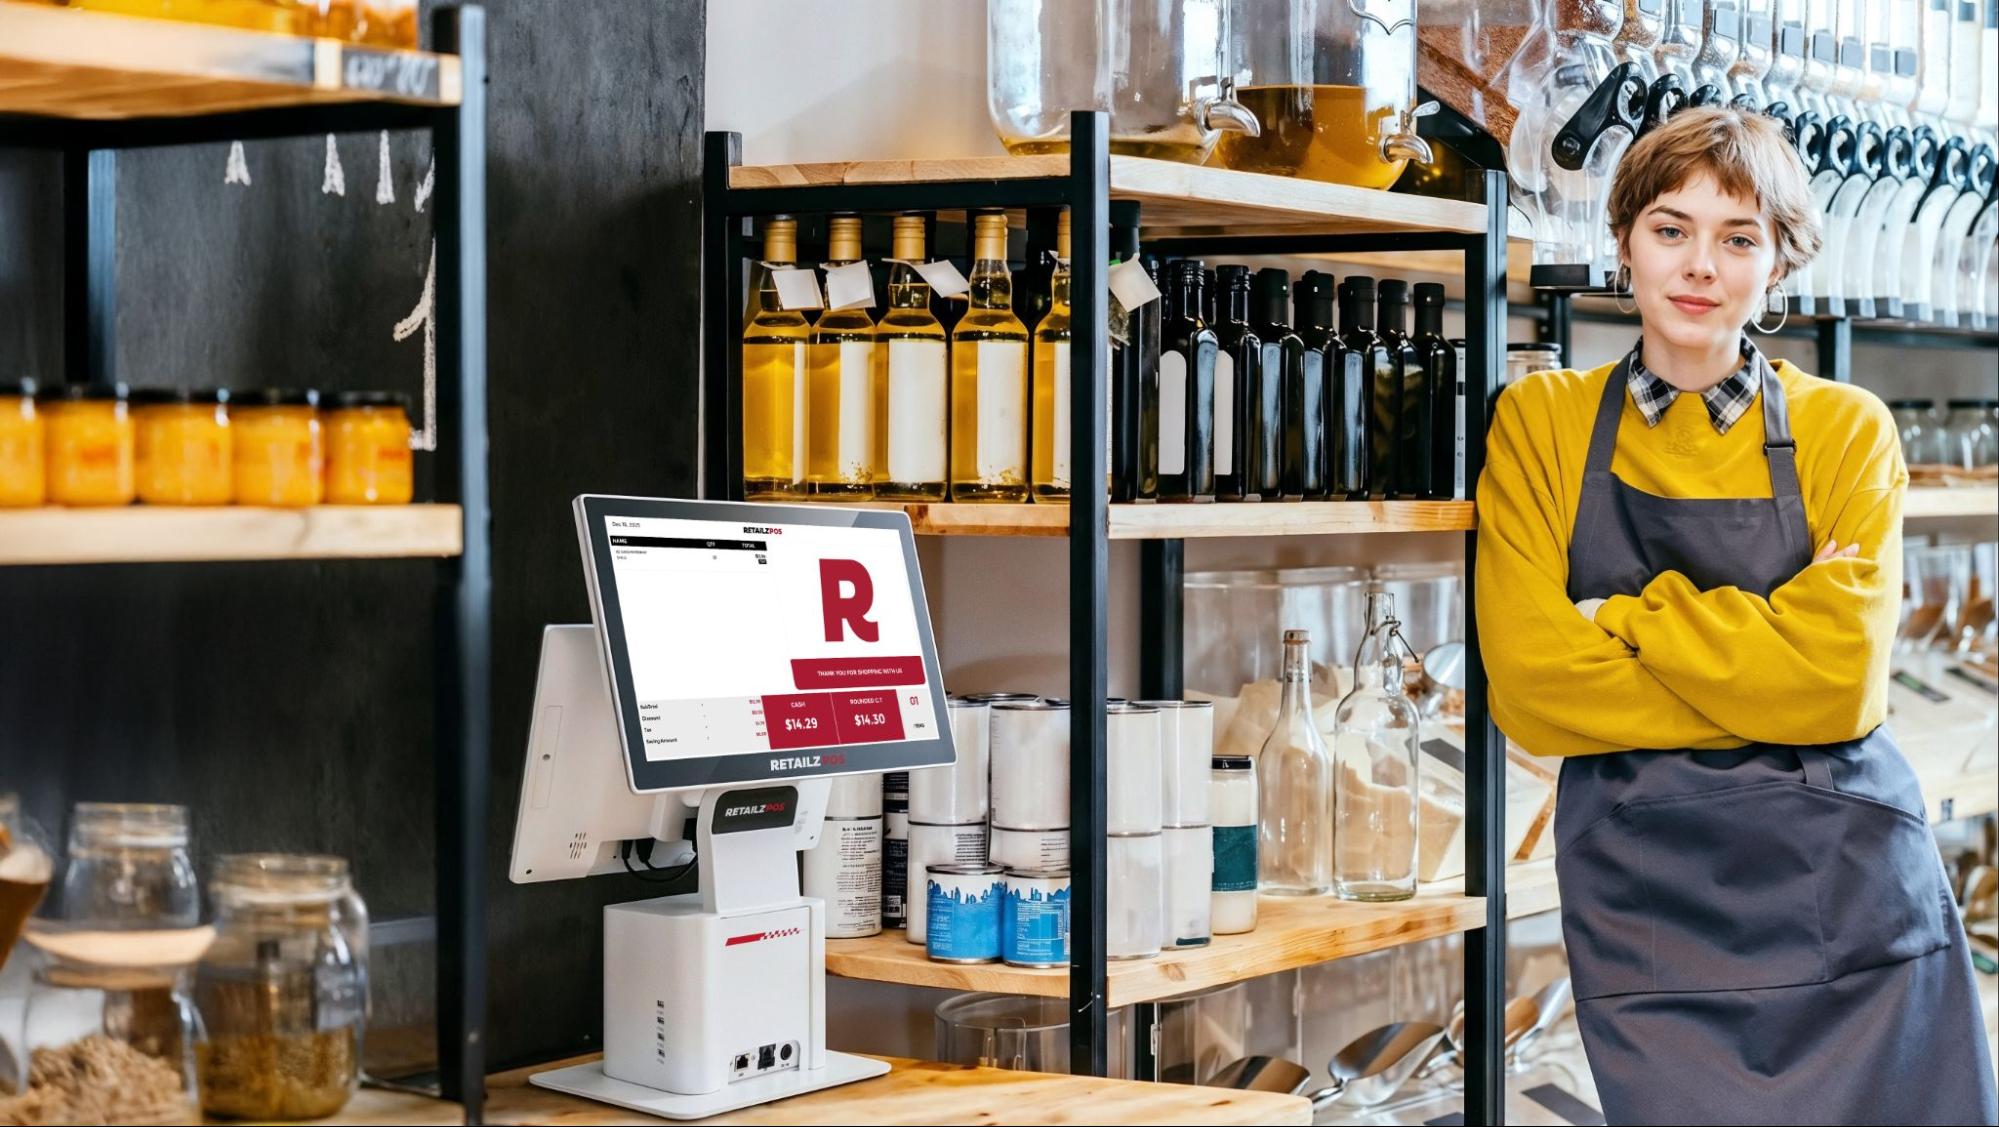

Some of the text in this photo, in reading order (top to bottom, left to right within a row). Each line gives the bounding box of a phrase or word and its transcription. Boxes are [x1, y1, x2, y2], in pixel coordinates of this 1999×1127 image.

[743, 527, 782, 535] RETAILZPOS
[819, 559, 880, 643] R
[909, 696, 919, 706] 01
[785, 717, 818, 732] $14.29
[854, 713, 886, 727] $14.30
[770, 754, 845, 771] RETAILZPOS
[725, 803, 784, 817] RETAILZPOS
